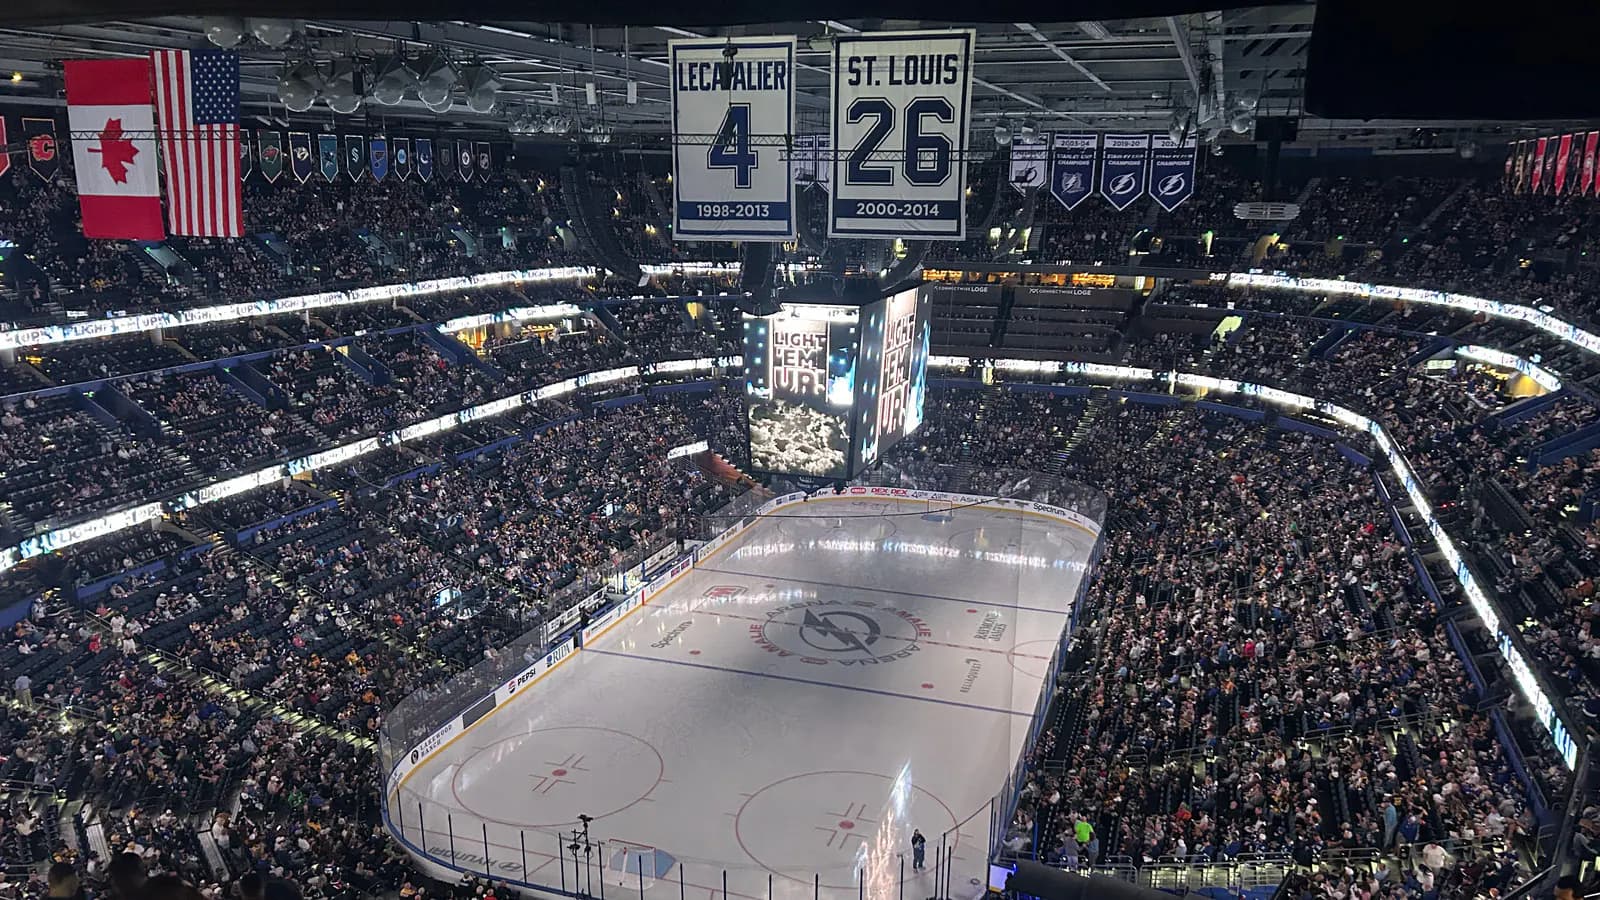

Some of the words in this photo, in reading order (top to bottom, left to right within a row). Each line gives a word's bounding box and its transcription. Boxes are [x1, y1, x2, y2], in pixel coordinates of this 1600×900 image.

[678, 61, 786, 91] LECAALIER
[847, 56, 880, 87] ST.
[889, 53, 959, 86] LOUIS
[707, 102, 759, 189] 4
[845, 96, 955, 186] 26
[696, 203, 770, 217] 1998-2013
[855, 202, 940, 217] 2000-2014
[775, 331, 826, 347] LIGHT
[1033, 501, 1067, 517] Spectrum
[650, 620, 693, 649] Spectrum
[517, 667, 536, 686] PEPSI
[419, 724, 453, 751] LAKEWOOD
[427, 846, 497, 867] HYUNDAI
